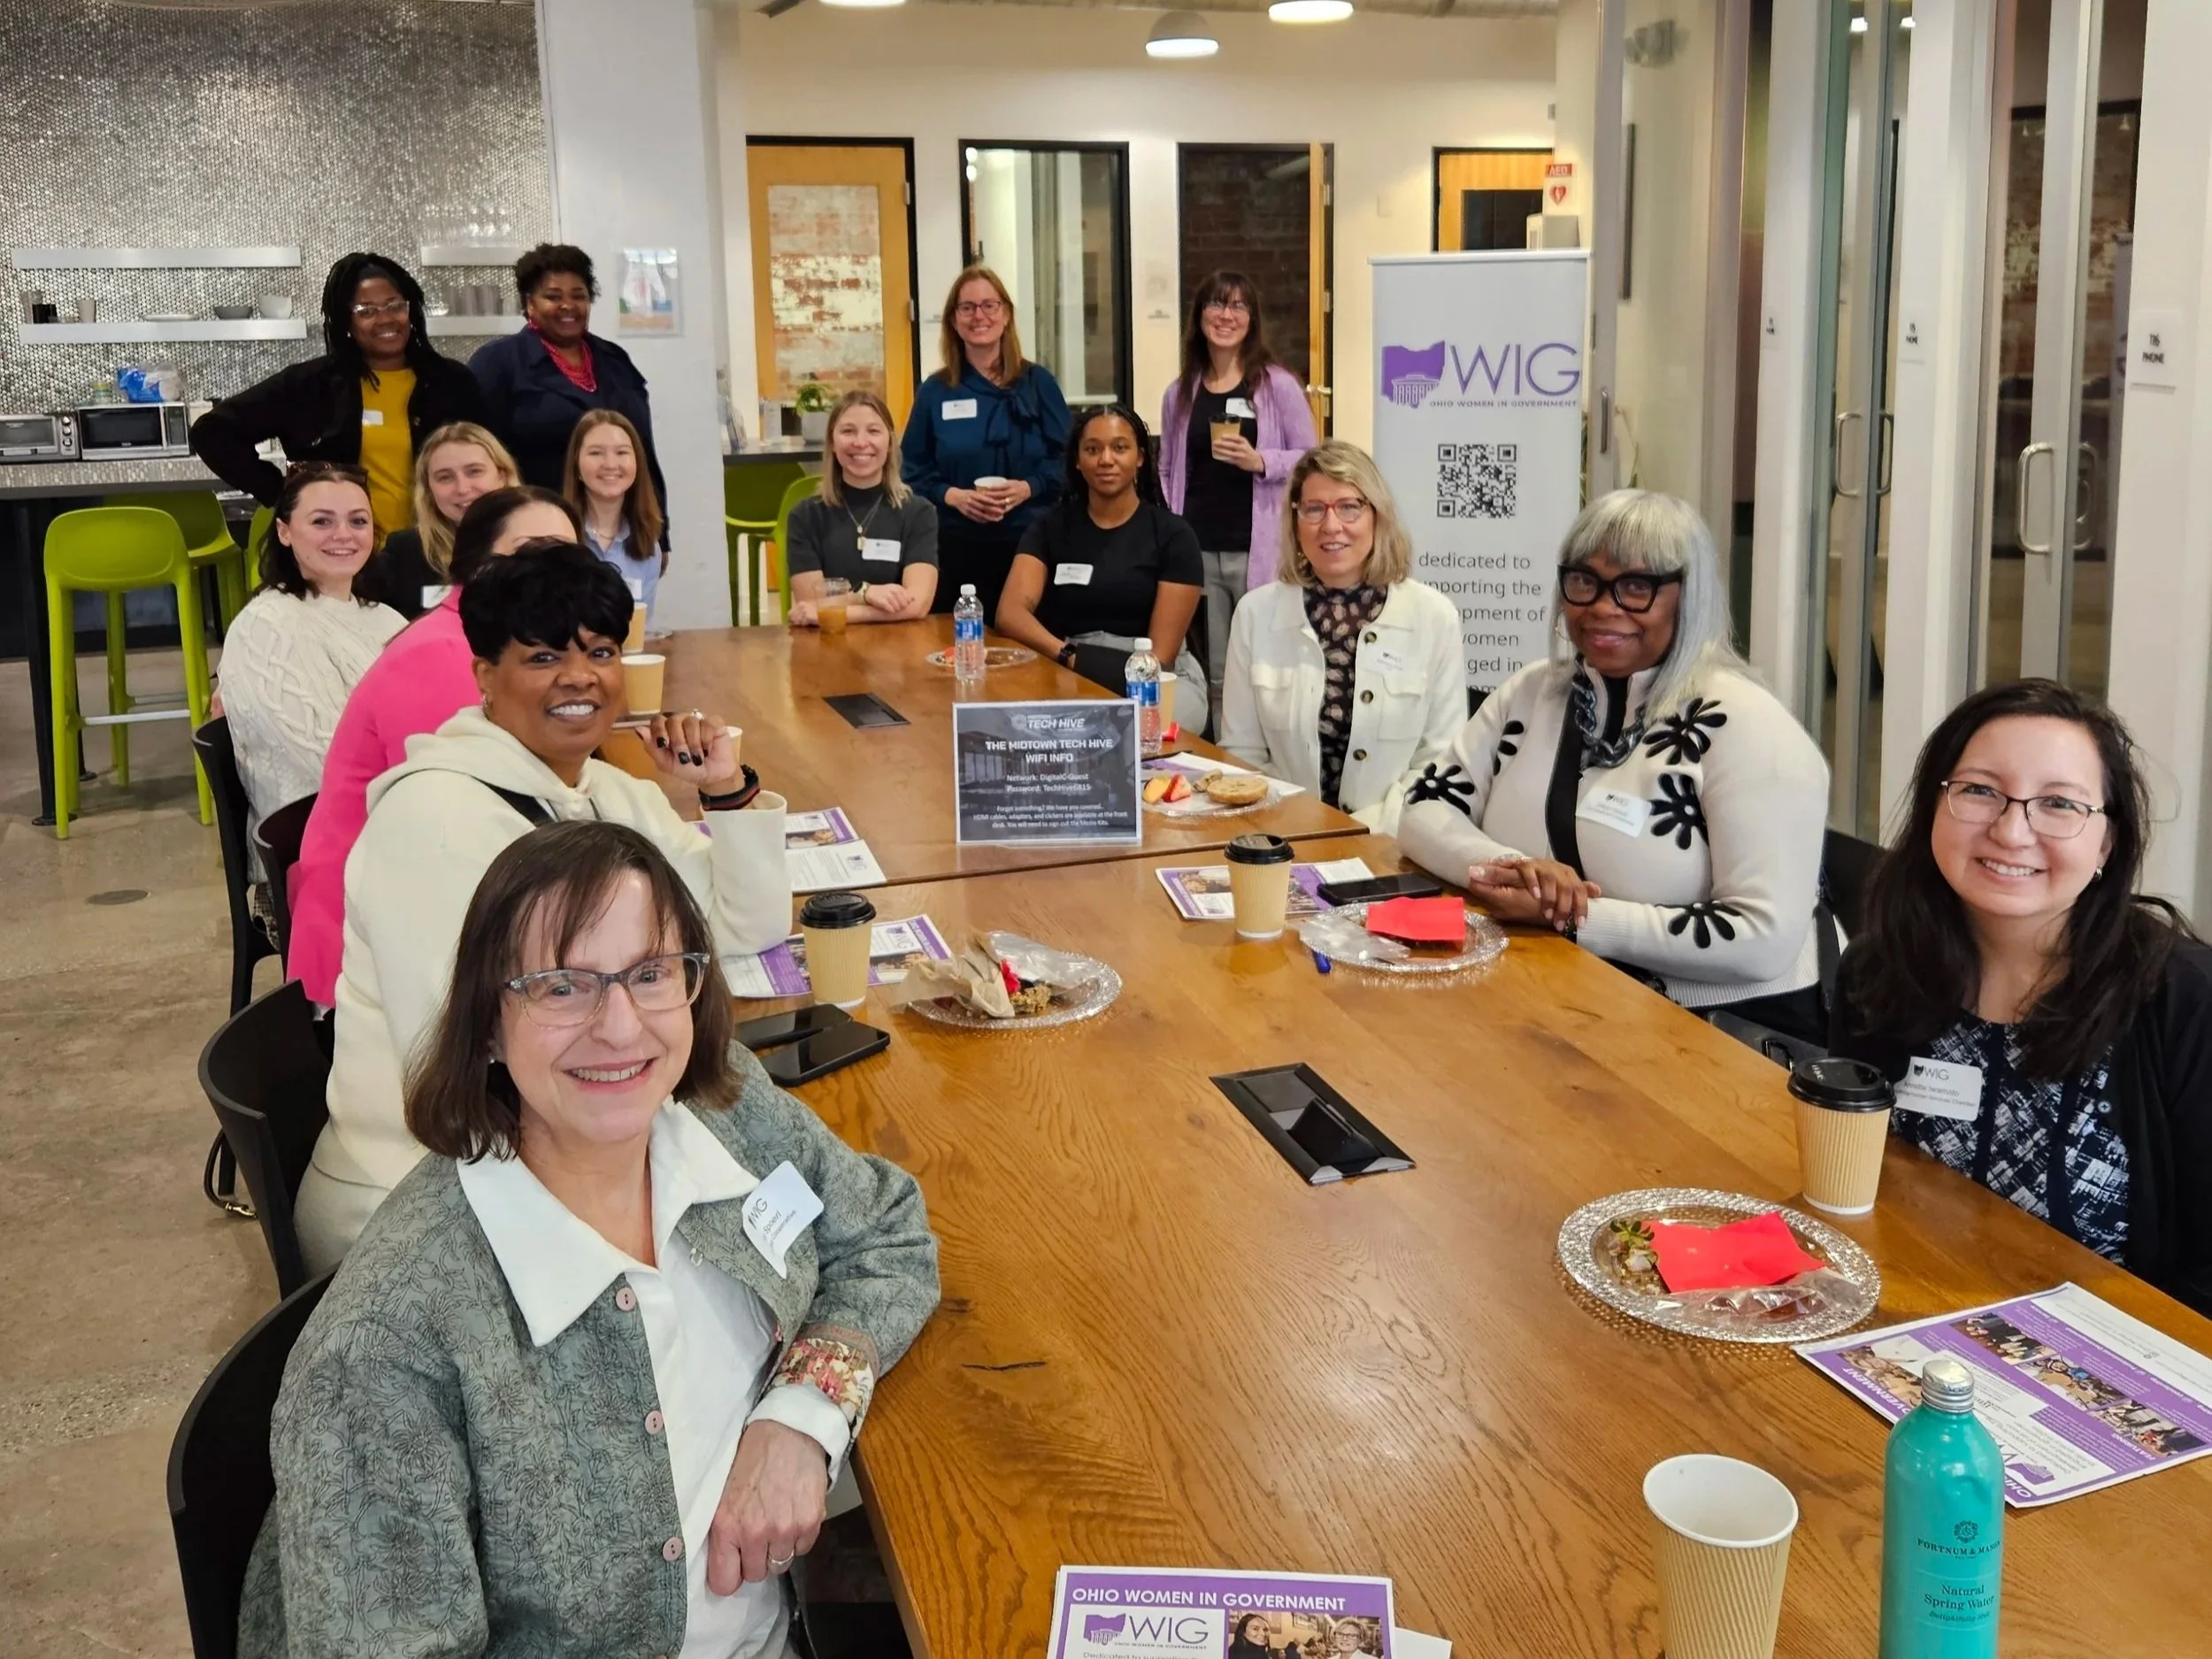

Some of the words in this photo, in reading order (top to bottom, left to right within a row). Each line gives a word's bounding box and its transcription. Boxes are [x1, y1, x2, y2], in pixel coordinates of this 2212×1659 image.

[1549, 165, 1567, 174] AED
[1450, 342, 1580, 396] WIG
[1418, 552, 1506, 569] dedicated
[1513, 556, 1531, 570] to
[1425, 580, 1505, 598] porting
[1512, 580, 1541, 595] the
[1527, 606, 1546, 622] of
[1507, 657, 1523, 672] in
[1028, 719, 1057, 729] TECH
[1058, 718, 1085, 728] HIVE
[985, 741, 1006, 750] THE
[1009, 740, 1056, 750] MIDTOWN
[1059, 739, 1087, 749] TECH
[1088, 738, 1113, 749] HIVE
[1025, 753, 1048, 763] WIFI
[1049, 752, 1074, 762] INFO
[1924, 1067, 1949, 1080] WIG
[748, 1198, 768, 1230] WIG
[1842, 1367, 1911, 1414] OVERNMENT
[2004, 1478, 2032, 1498] OHI
[1917, 1538, 1967, 1555] FORTNUM
[1072, 1587, 1119, 1602] OHIO
[1125, 1589, 1194, 1605] WOMEN
[1200, 1592, 1217, 1606] IN
[1223, 1593, 1346, 1610] GOVERNMENT
[1941, 1585, 1985, 1596] Natural
[1924, 1594, 1964, 1611] Spring
[1968, 1595, 1995, 1609] Water
[1129, 1616, 1209, 1645] WIG
